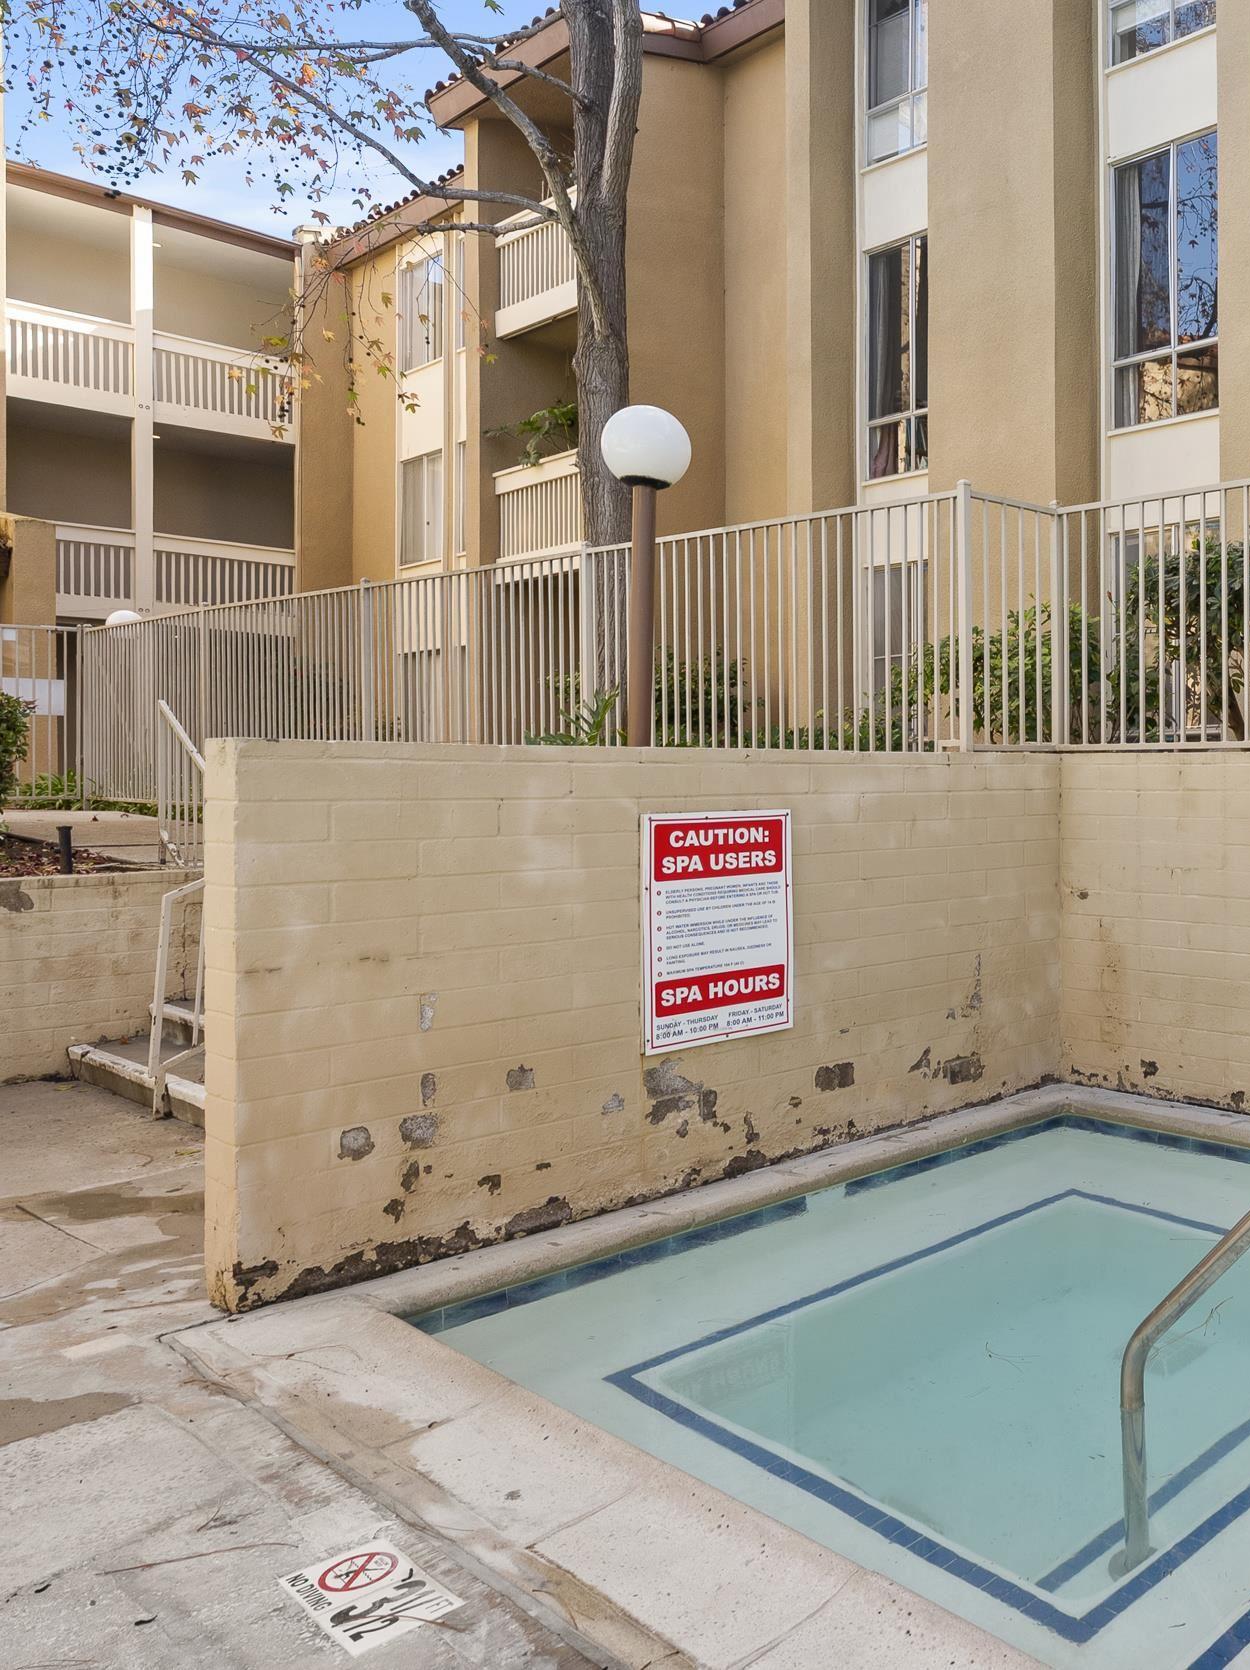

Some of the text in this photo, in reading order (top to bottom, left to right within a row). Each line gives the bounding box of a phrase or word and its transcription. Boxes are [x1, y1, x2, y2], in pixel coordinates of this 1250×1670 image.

[669, 826, 769, 848] CAUTION:
[662, 850, 776, 874] SPA USERS
[661, 973, 780, 1007] SPA HOURS
[727, 1018, 739, 1027] 8:00
[741, 1016, 752, 1024] AM
[758, 1012, 773, 1022] 11:00
[775, 1010, 784, 1019] PM
[728, 1009, 750, 1018] FRIDAY
[754, 1003, 782, 1014] SATURDAY
[656, 1020, 684, 1031] SUNDAY
[686, 1014, 718, 1026] THURSDAY
[656, 1031, 670, 1040] 8:00
[690, 1024, 707, 1035] 10:00
[709, 1023, 719, 1032] PM
[285, 1573, 332, 1611] NO DIVING
